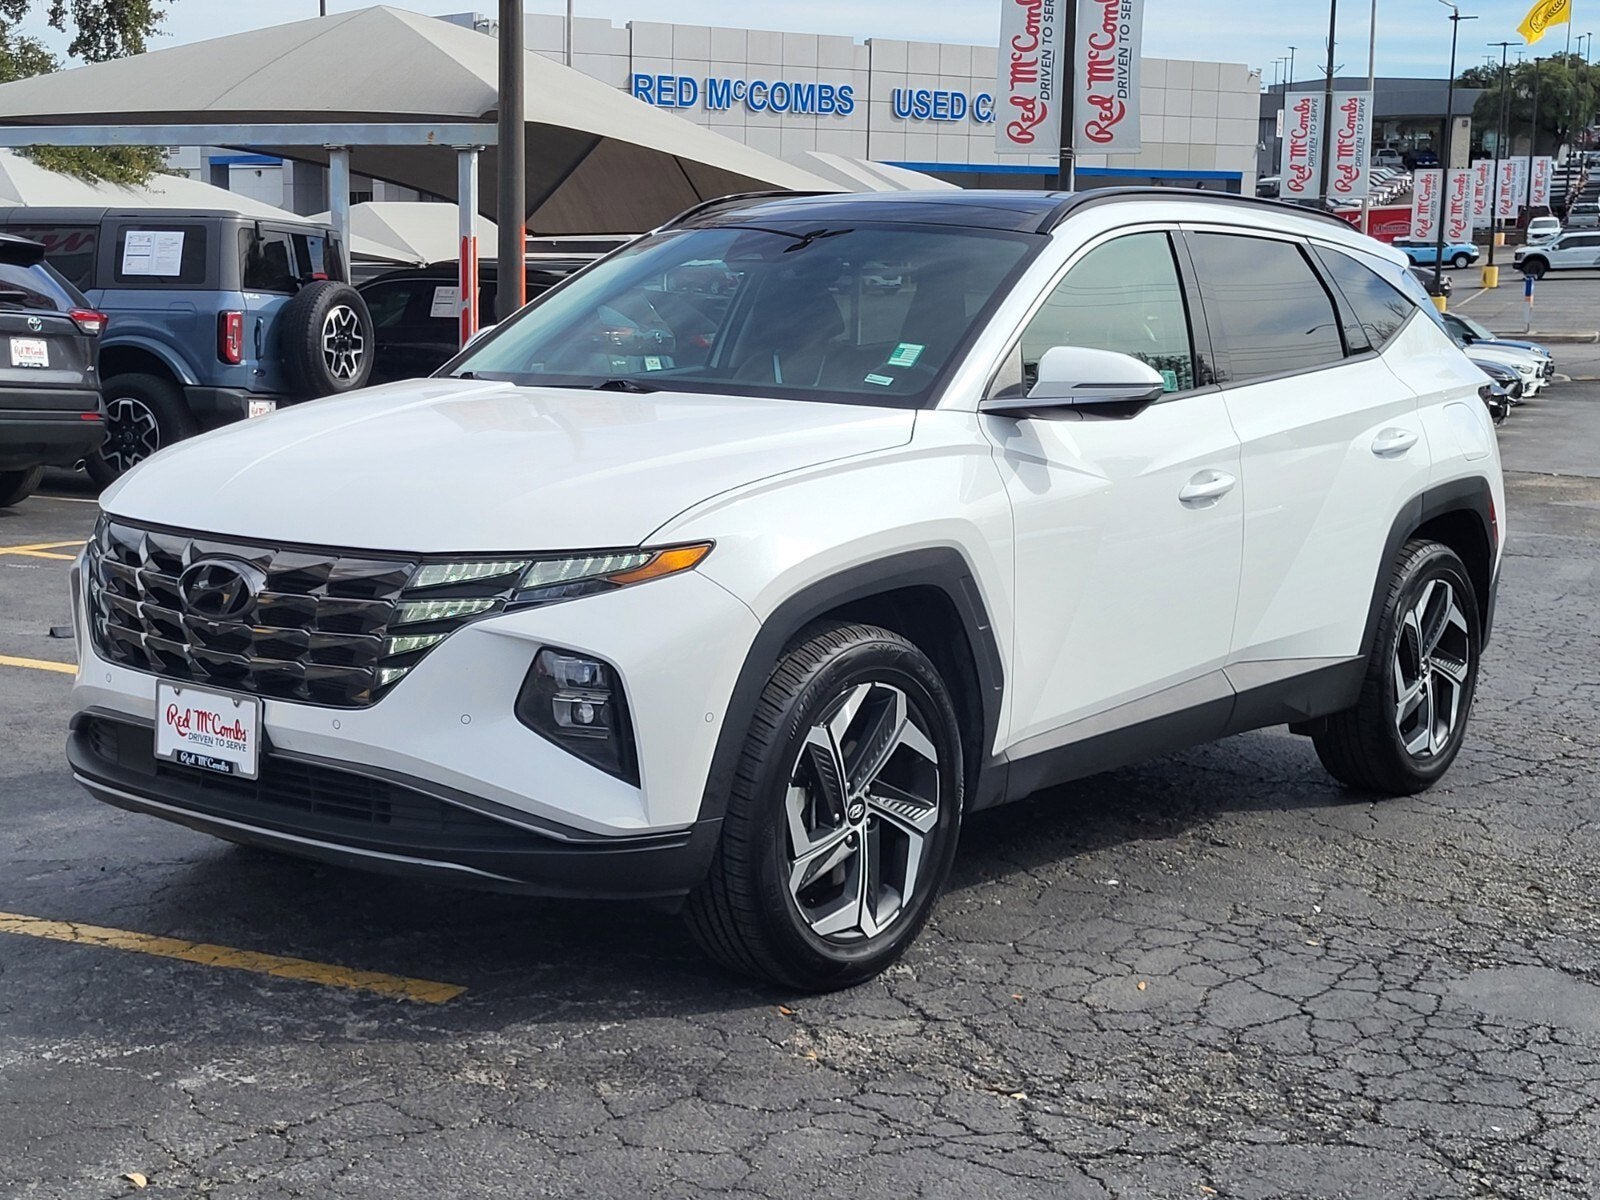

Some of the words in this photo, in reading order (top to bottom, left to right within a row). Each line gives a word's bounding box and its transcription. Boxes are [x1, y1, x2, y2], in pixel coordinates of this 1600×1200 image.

[1042, 27, 1053, 45] TO
[1087, 0, 1119, 90] McCom
[1119, 24, 1130, 42] TO
[633, 72, 699, 108] RED
[1040, 49, 1052, 100] DRIVEN
[1118, 47, 1129, 99] DRIVEN
[893, 88, 967, 122] USED
[1006, 96, 1047, 144] Red
[1085, 95, 1125, 143] Red
[1290, 98, 1311, 161] McCombs
[1337, 97, 1358, 161] McCombs
[1287, 164, 1312, 192] Red
[1334, 164, 1360, 192] Red
[166, 703, 191, 737] Red
[193, 709, 247, 742] McCombs
[188, 732, 213, 745] DRIVEN
[215, 738, 225, 747] TO
[226, 740, 247, 752] SERVE
